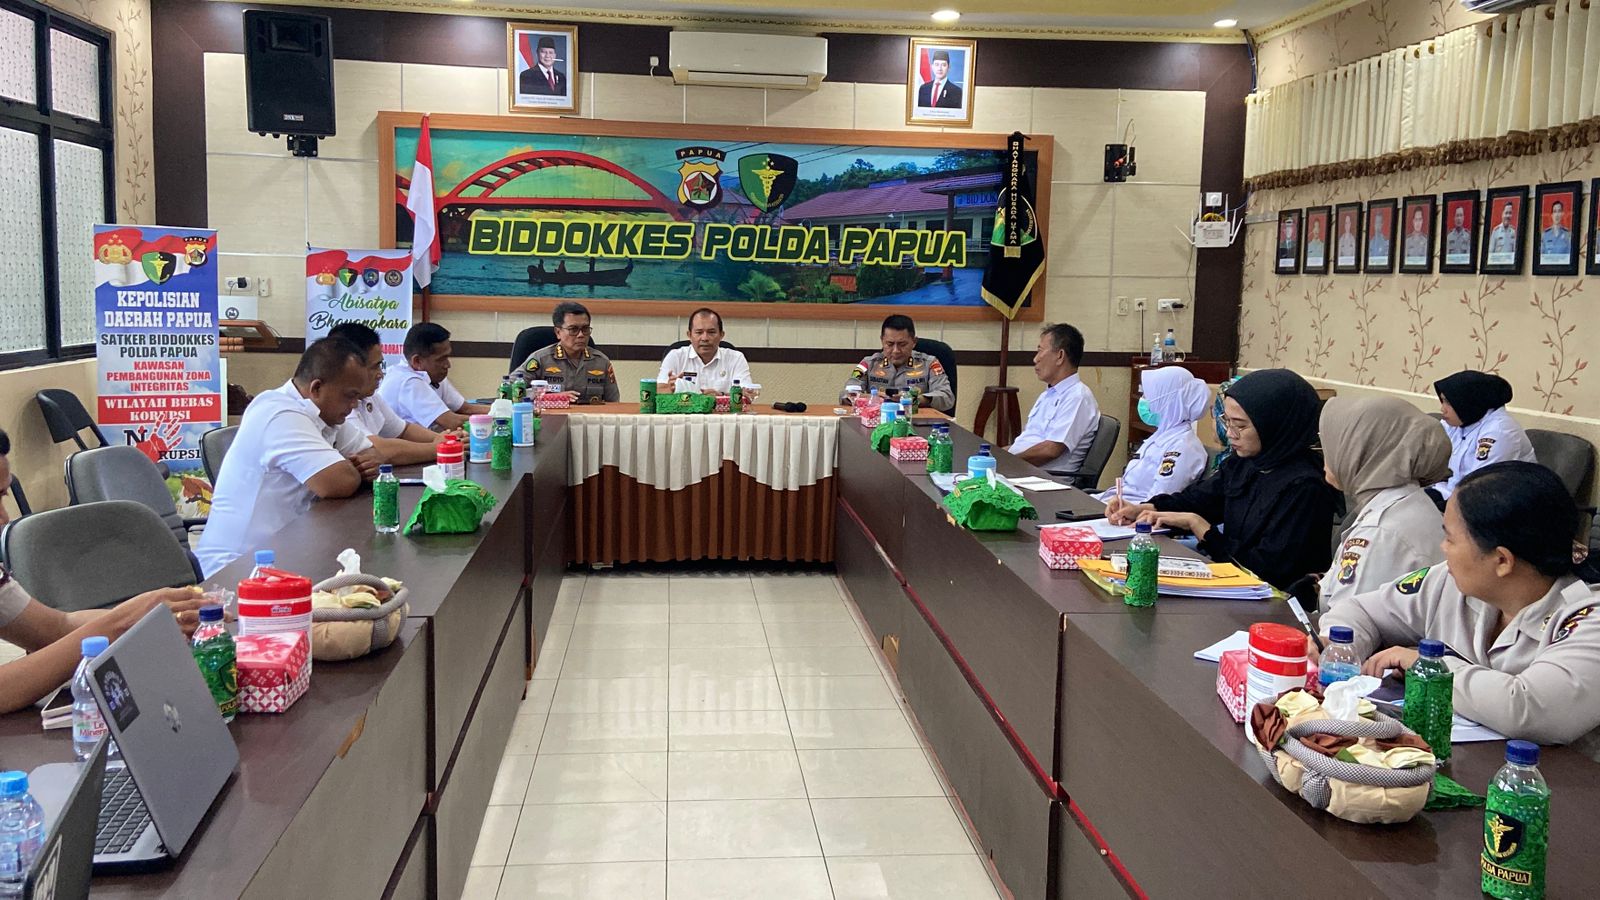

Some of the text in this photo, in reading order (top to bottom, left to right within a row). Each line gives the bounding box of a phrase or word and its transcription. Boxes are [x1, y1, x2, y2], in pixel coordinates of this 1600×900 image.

[680, 149, 721, 159] PAPUA
[469, 217, 967, 268] BIDDOKKES POLDA PAPUA
[117, 290, 200, 308] KEPOLISIAN
[328, 293, 399, 315] Abisatya
[104, 311, 163, 328] DAERAH
[166, 312, 213, 328] PAPUA
[101, 333, 214, 345] SATKER BIDDOKKES
[120, 346, 198, 358] POLDA PAPUA
[134, 361, 184, 370] KAWASAN
[107, 372, 211, 381] PEMBANGUNAN ZONA
[130, 382, 189, 391] INTEGRITAS
[105, 397, 214, 409] WILAYAH BEBAS
[1497, 869, 1528, 883] PAPUA
